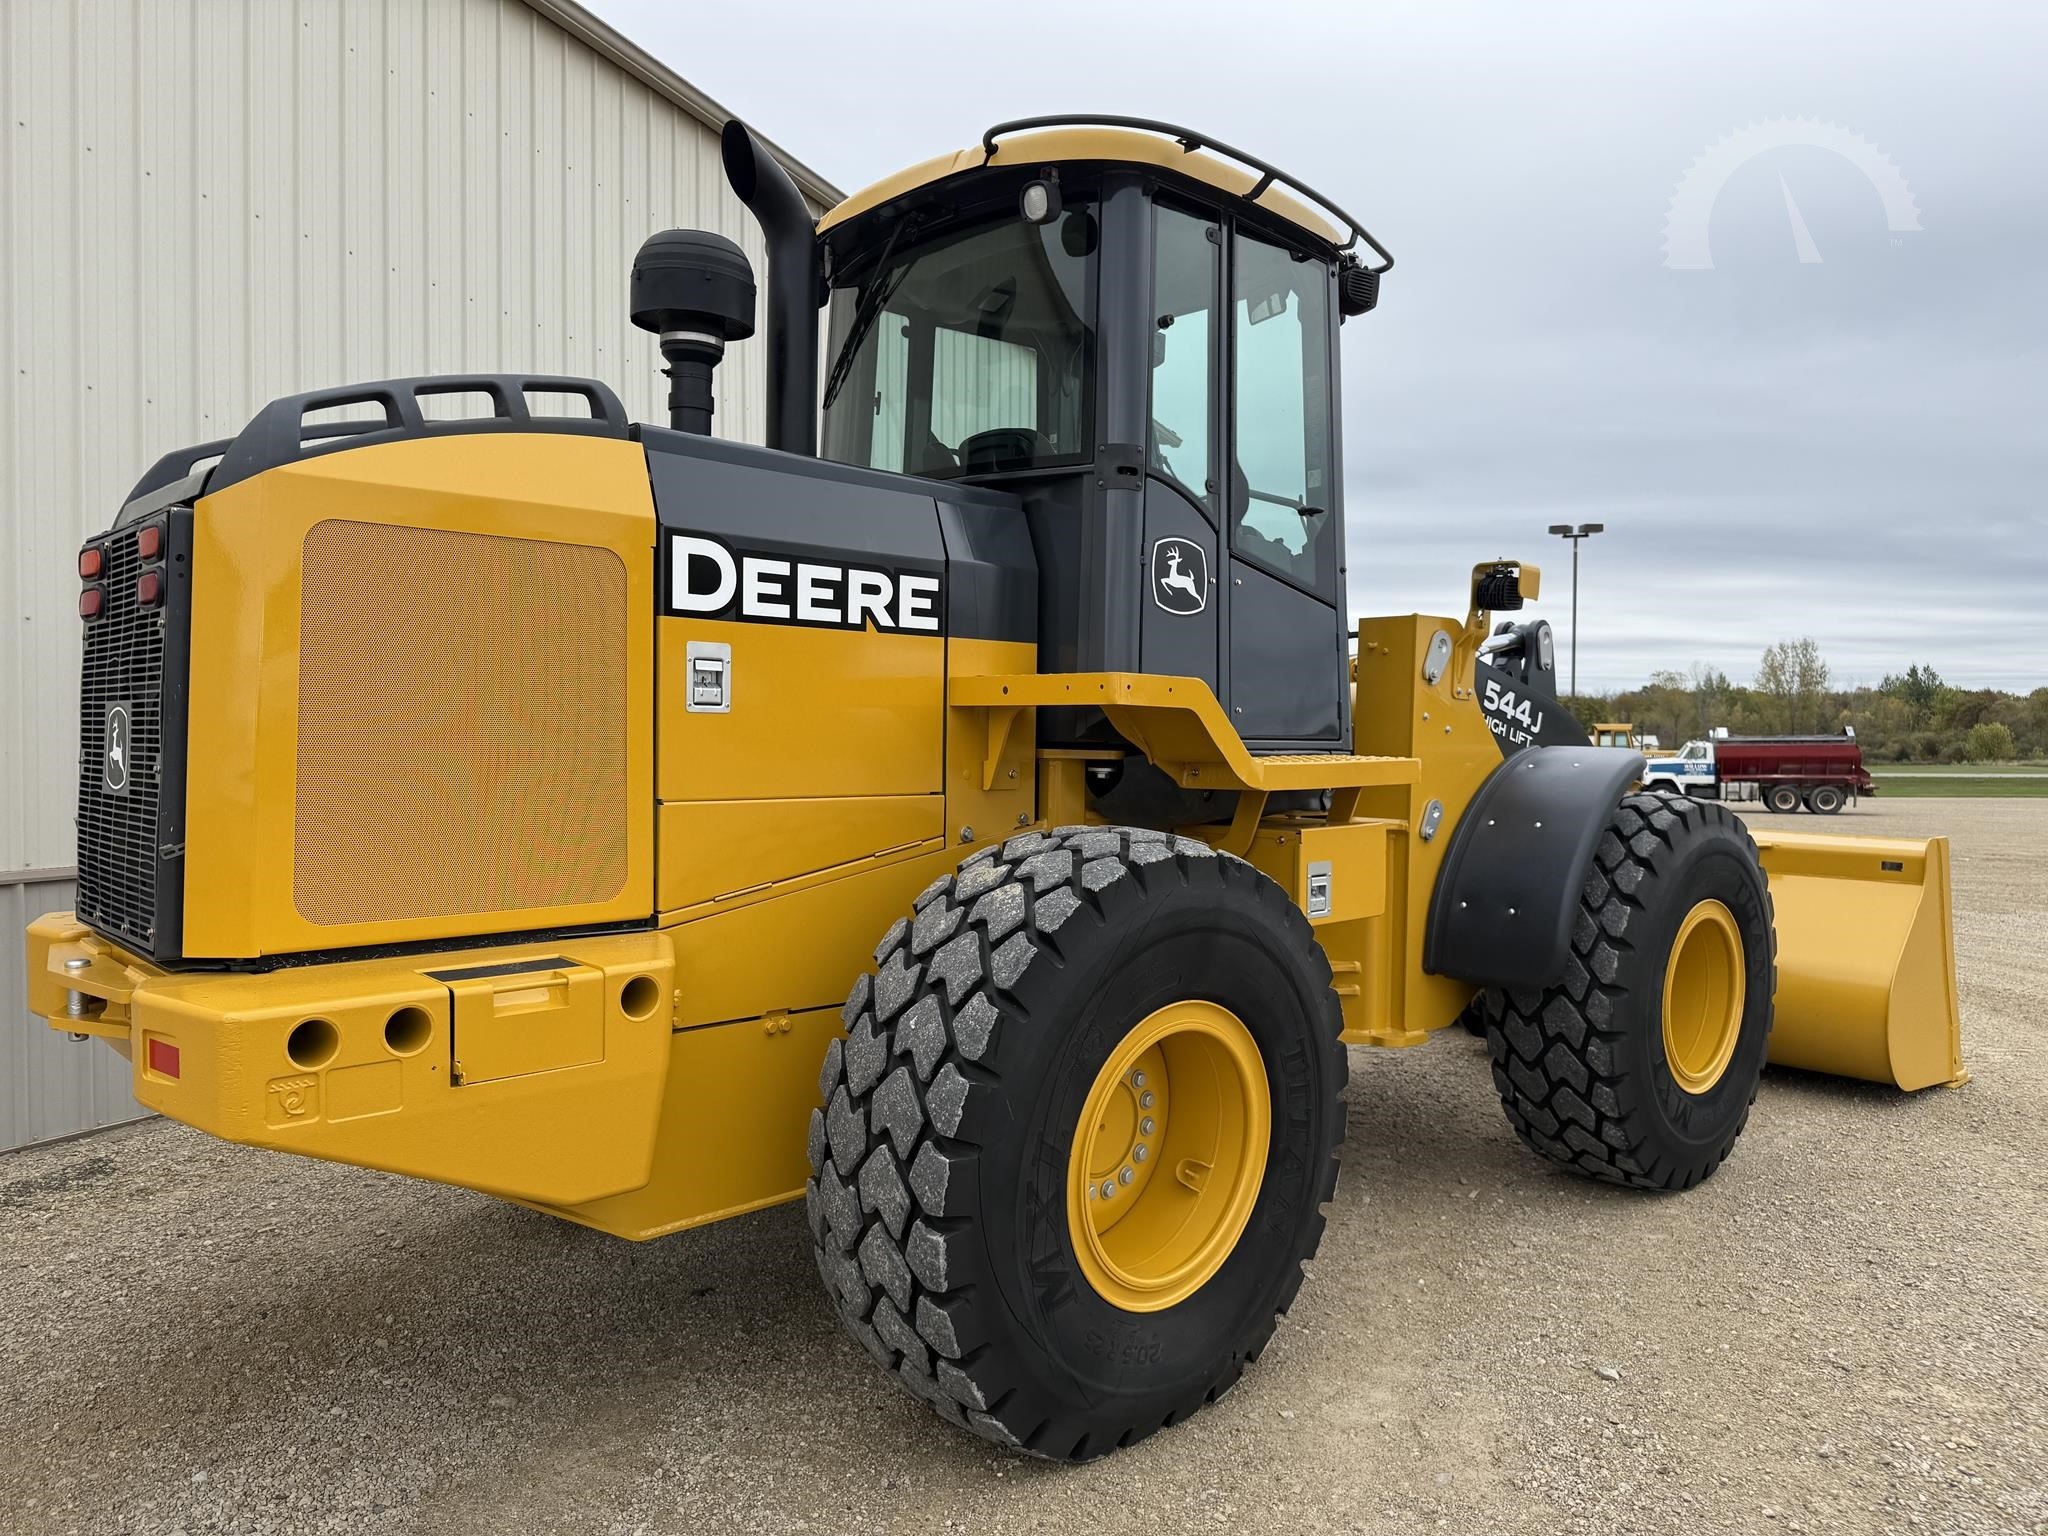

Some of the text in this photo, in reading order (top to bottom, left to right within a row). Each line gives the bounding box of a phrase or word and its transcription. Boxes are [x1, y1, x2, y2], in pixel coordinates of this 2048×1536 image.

[671, 534, 940, 631] DEERE
[1483, 679, 1543, 734] 544J
[1509, 727, 1533, 748] LIFT
